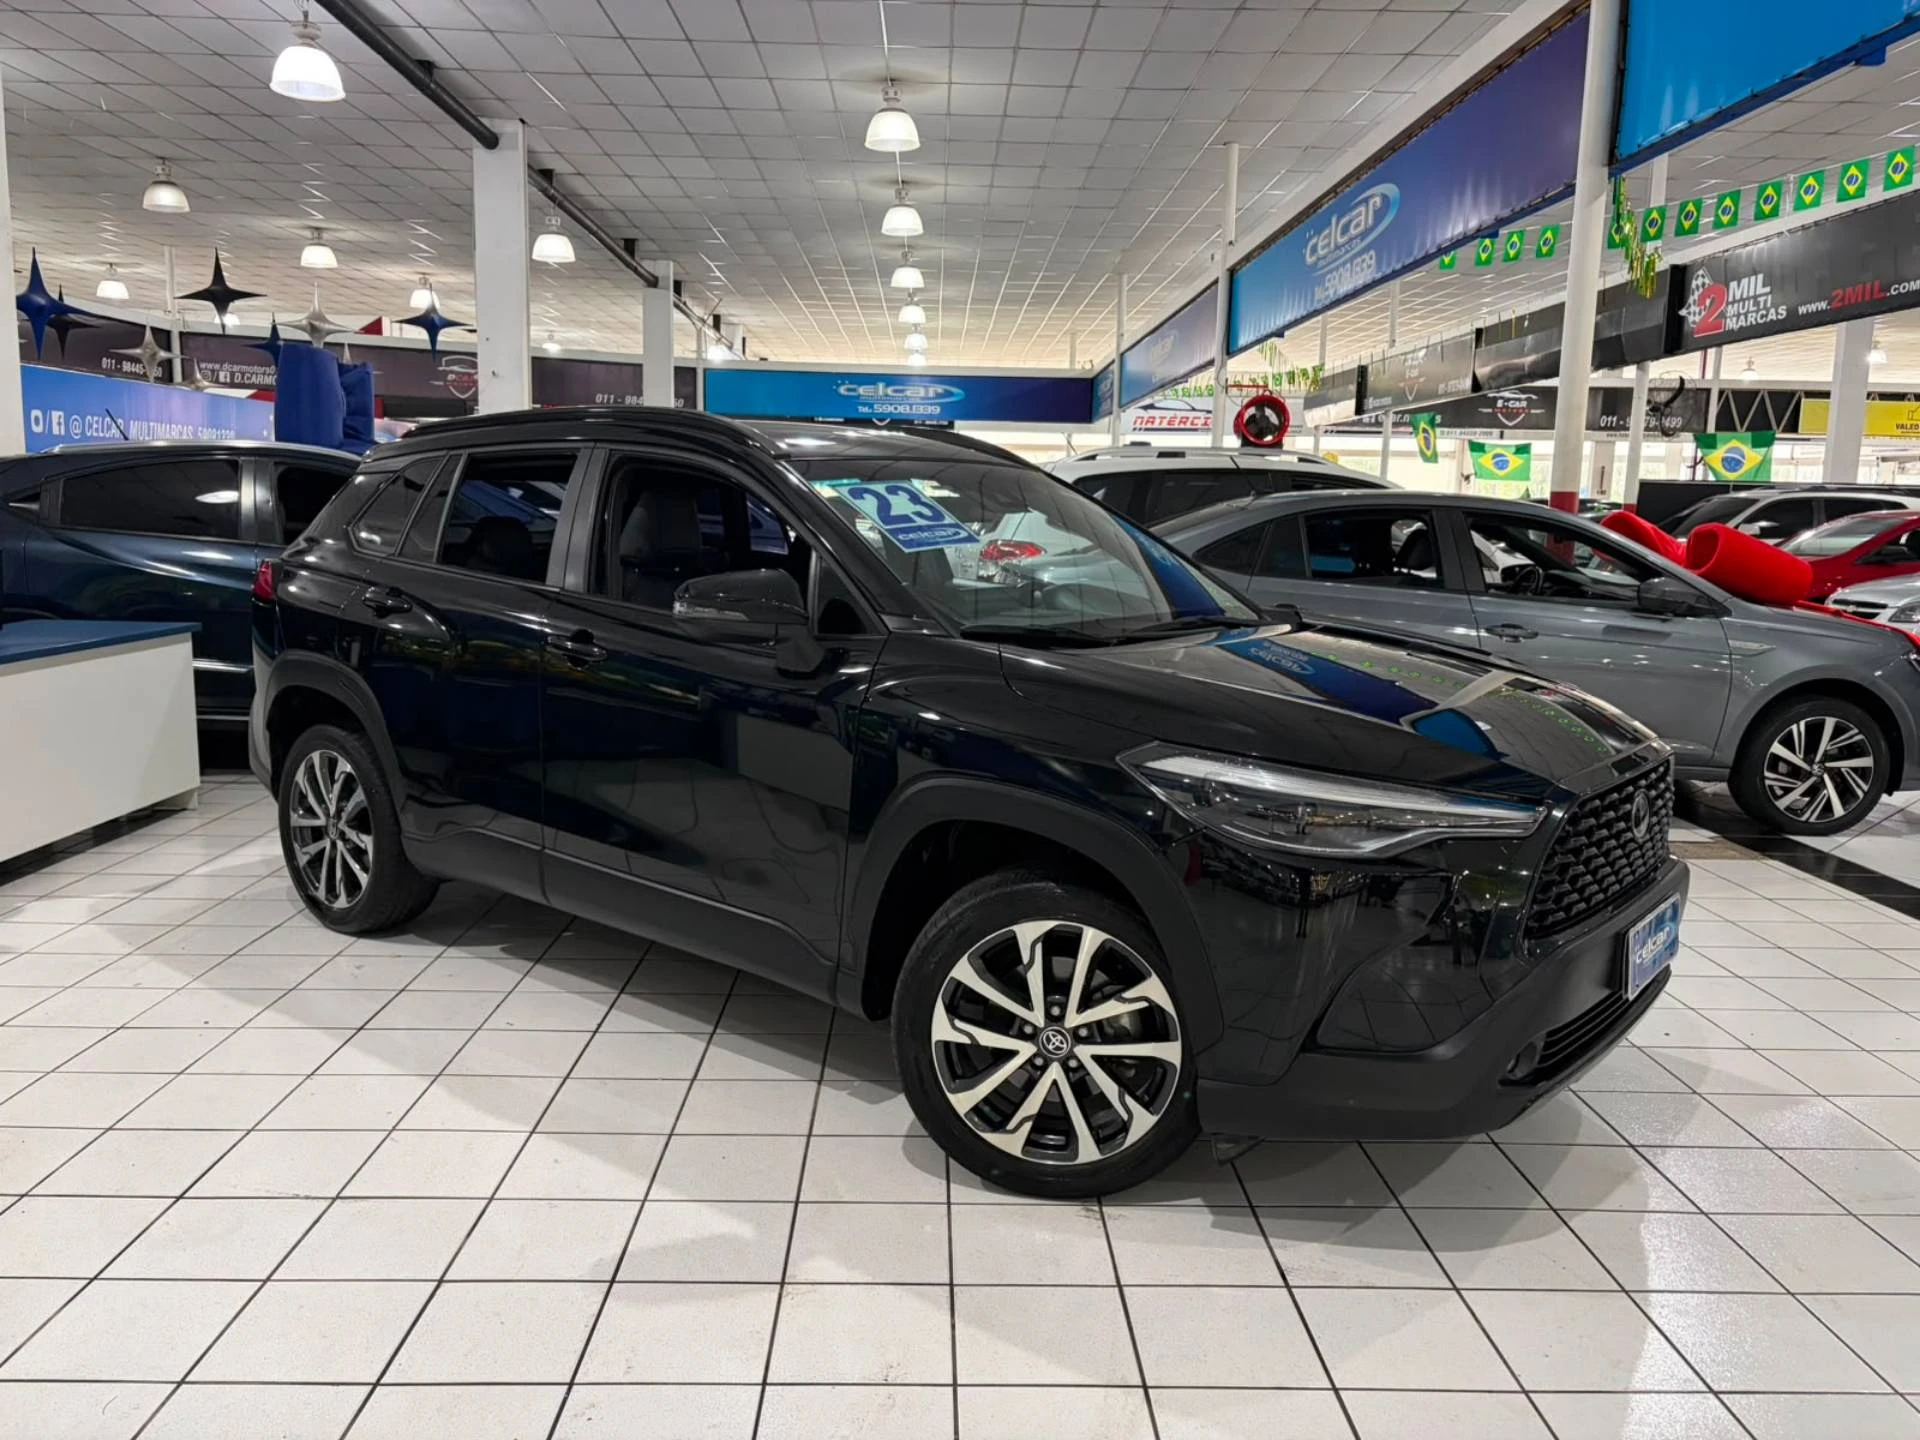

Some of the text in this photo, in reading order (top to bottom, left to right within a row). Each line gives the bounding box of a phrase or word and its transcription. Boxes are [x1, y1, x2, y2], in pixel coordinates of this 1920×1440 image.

[1305, 196, 1382, 265] celcar
[1693, 273, 1771, 338] 2 MIL
[1725, 305, 1787, 331] MARCAS
[1727, 294, 1772, 317] MULTI
[837, 382, 945, 398] celcar
[1600, 415, 1618, 427] 011
[847, 484, 946, 527] 23
[1636, 926, 1670, 964] celcar
